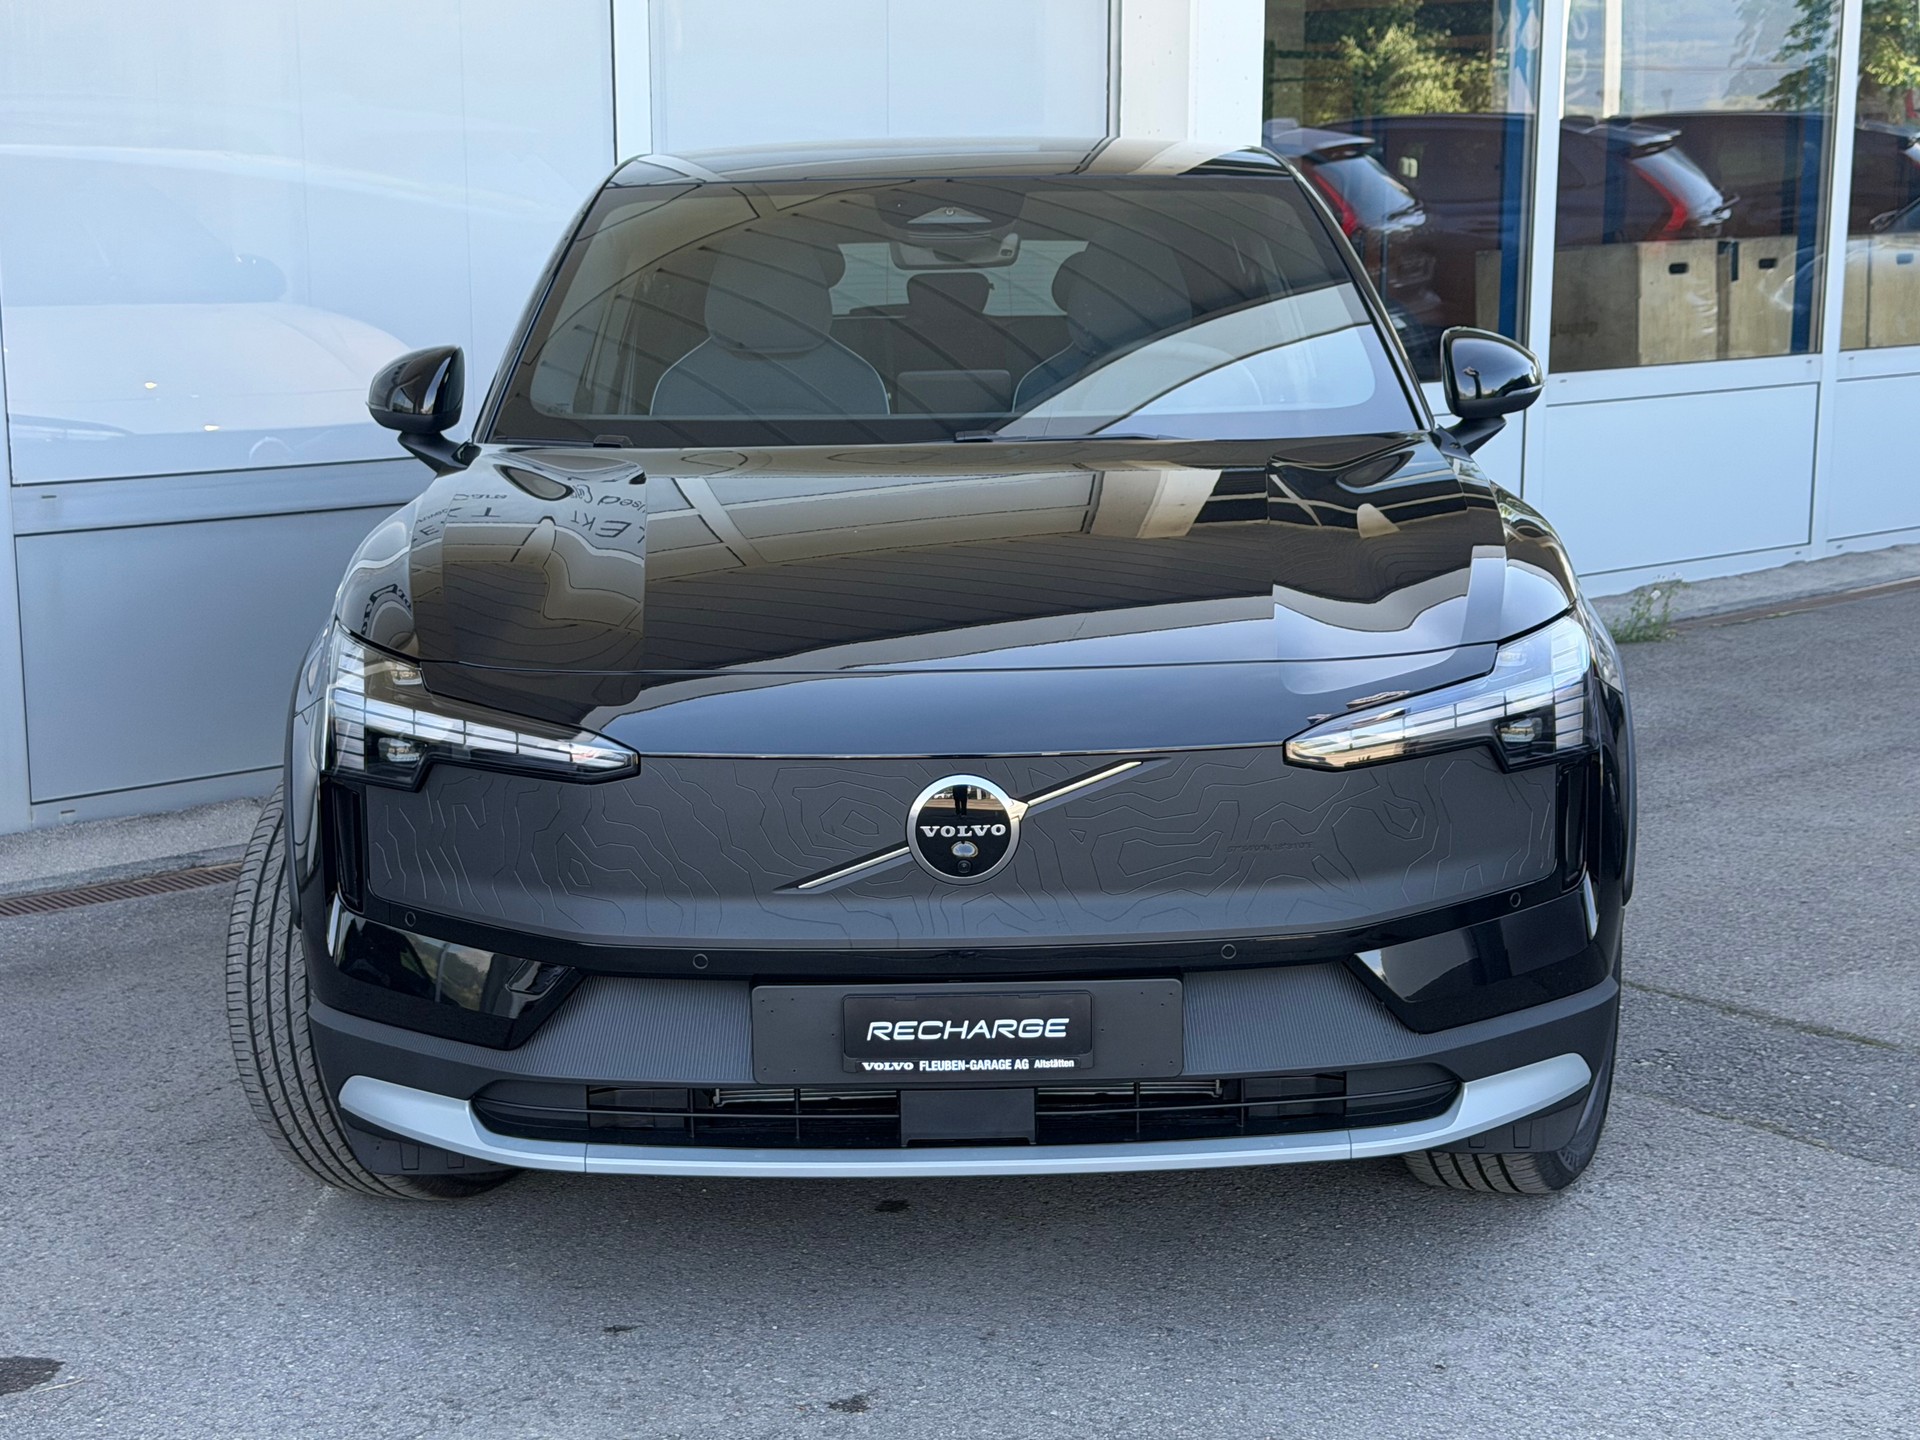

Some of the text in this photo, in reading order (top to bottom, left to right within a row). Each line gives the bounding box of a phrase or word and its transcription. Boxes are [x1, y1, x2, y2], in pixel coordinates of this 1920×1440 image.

[920, 824, 1006, 837] VOLVO
[867, 1018, 1070, 1041] RECHARGE
[862, 1059, 1075, 1072] VOLVO FLEUBEN-GARAGE AG Altstätten
